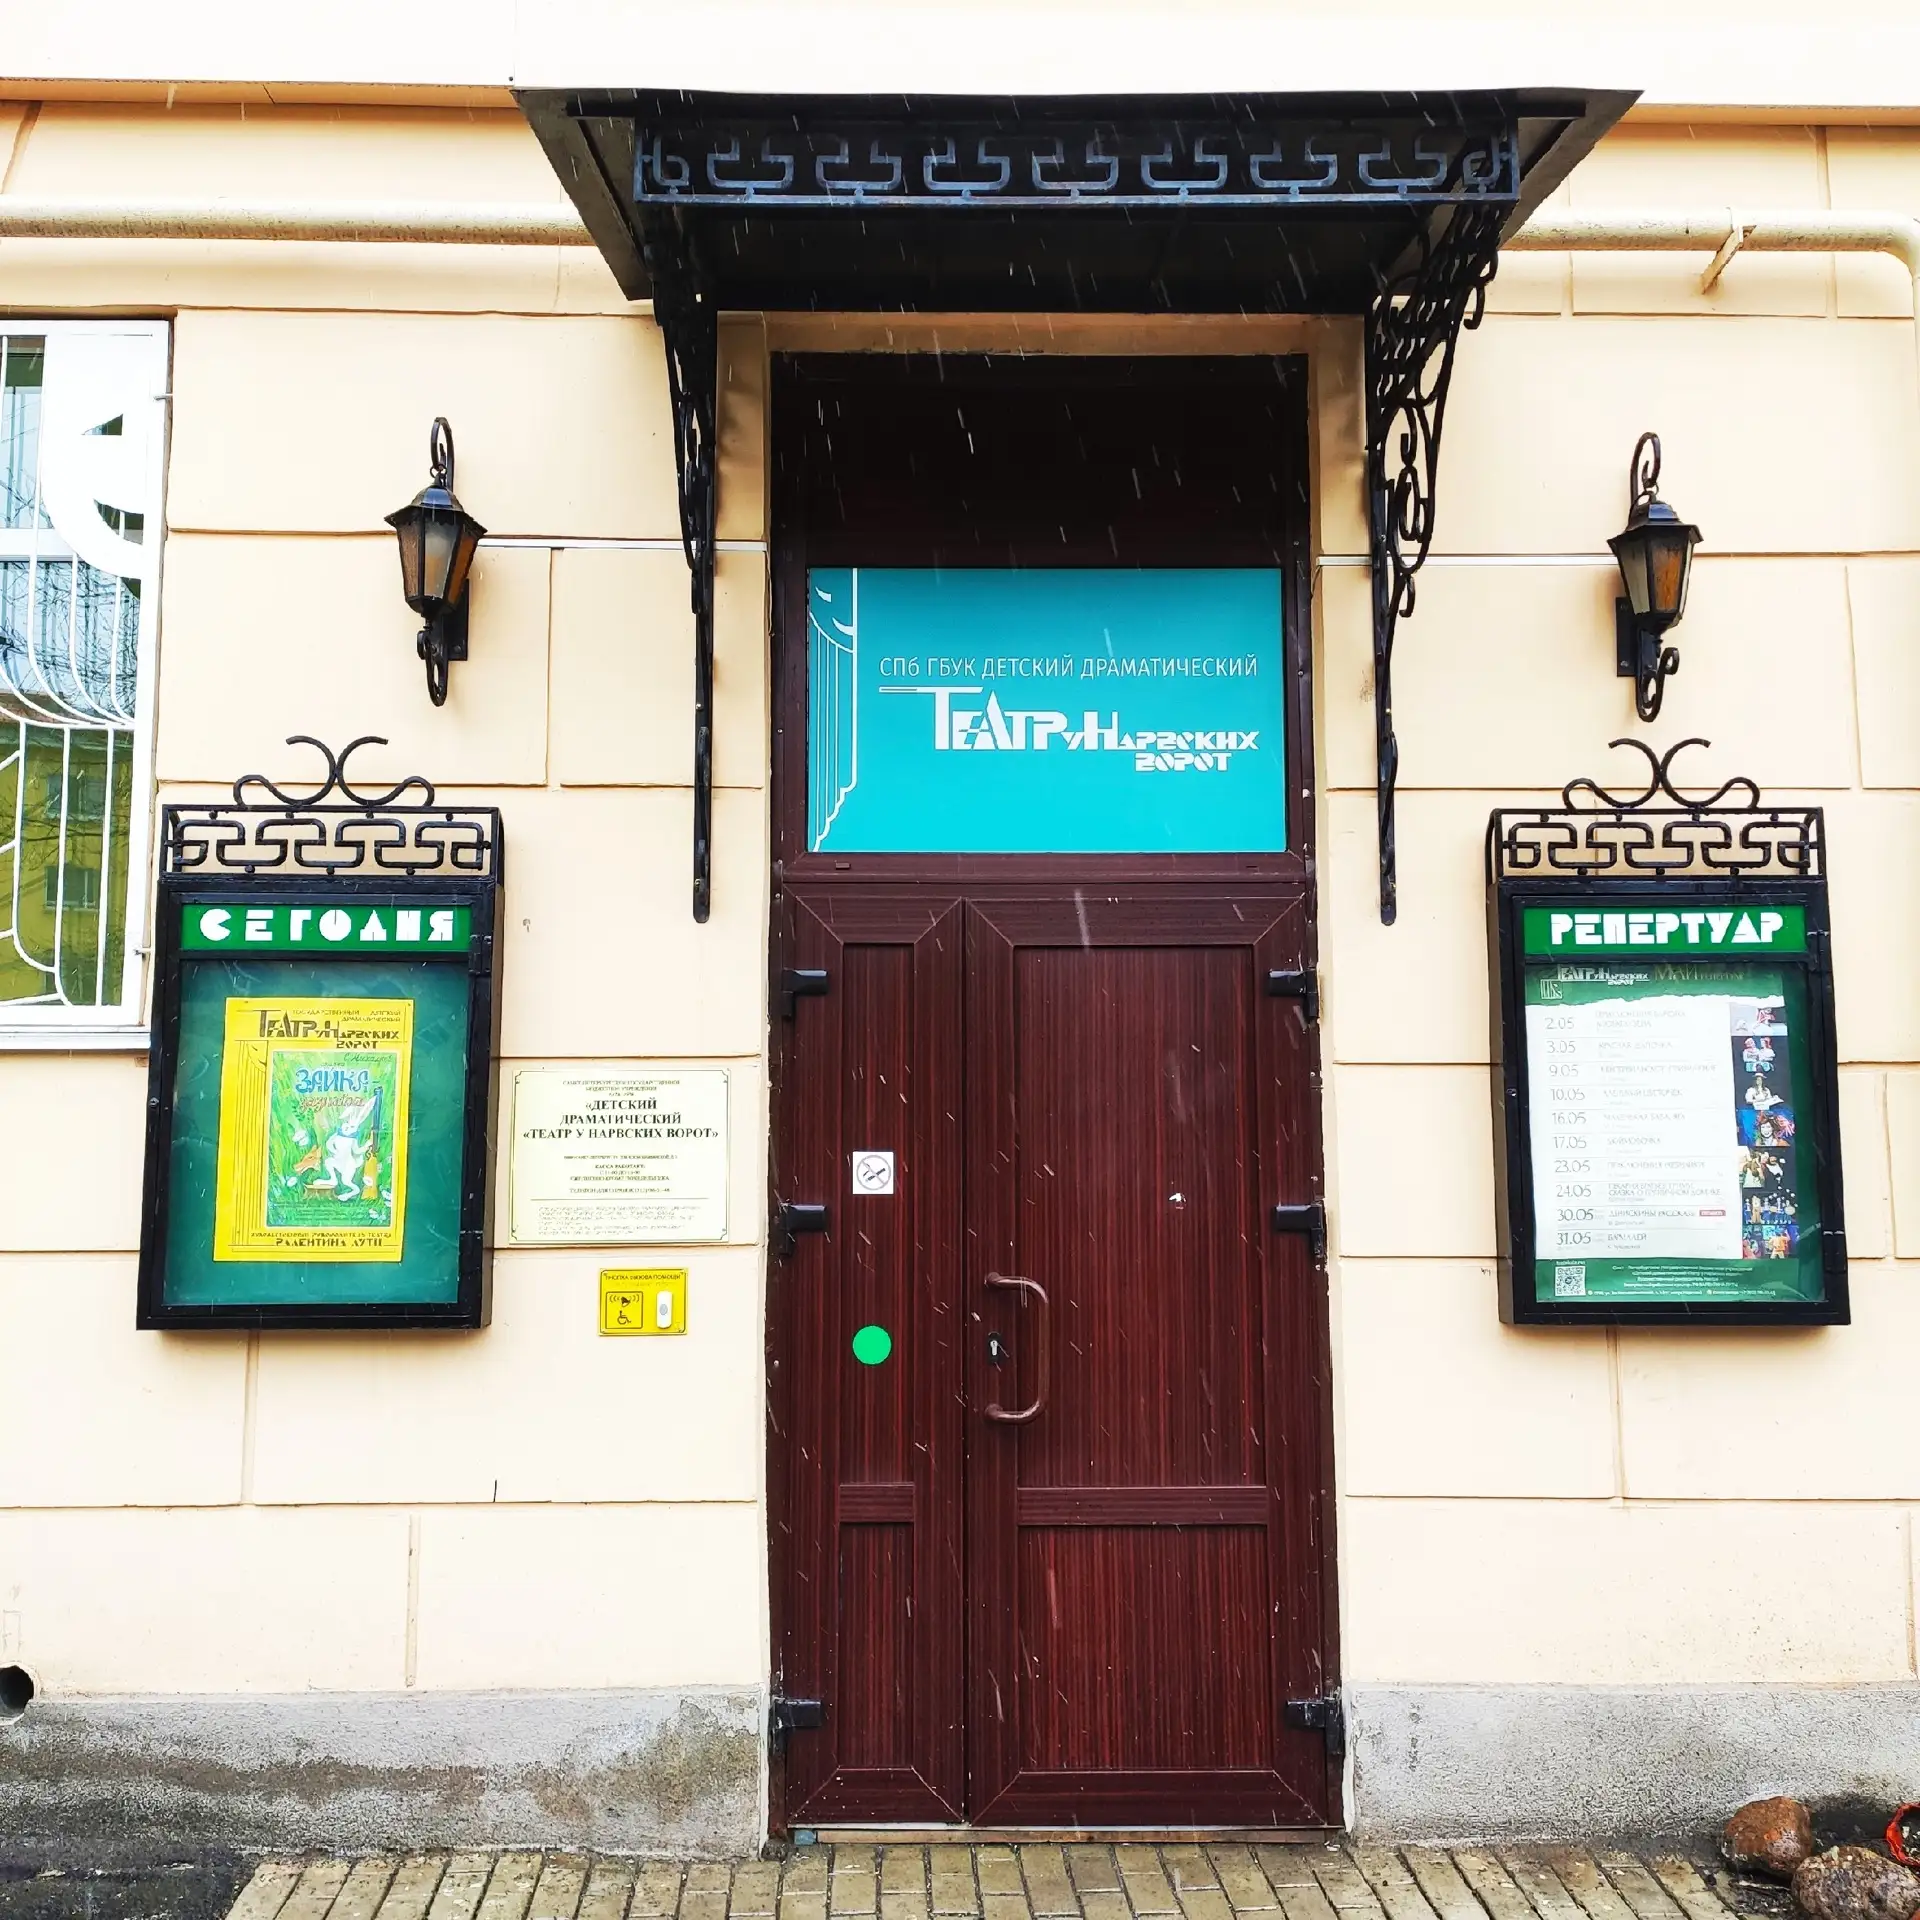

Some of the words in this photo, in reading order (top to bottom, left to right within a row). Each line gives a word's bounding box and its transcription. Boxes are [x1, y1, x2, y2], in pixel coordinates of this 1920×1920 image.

[879, 656, 920, 677] СПб
[928, 656, 976, 677] ГБУК
[981, 655, 1074, 680] ДЕТСКИЙ
[1080, 653, 1258, 680] ДРАМАТИЧЕСКИЙ
[199, 908, 454, 942] СЕГОДНЯ
[1550, 911, 1784, 945] РЕПЕРТУАР
[1544, 1017, 1575, 1030] 2.05
[1546, 1040, 1576, 1054] 3.05
[1548, 1064, 1579, 1077] 9.05
[1550, 1088, 1586, 1101] 10.05
[585, 1097, 657, 1111] «ДЕТСКИЙ
[560, 1111, 682, 1126] ДРАМАТИЧЕСКИЙ
[1551, 1112, 1587, 1125] 16.05
[523, 1128, 572, 1139] «ТЕАТР
[576, 1129, 585, 1139] У
[588, 1128, 662, 1139] НАРВСКИХ
[666, 1128, 719, 1138] ВОРОТ»
[1553, 1136, 1588, 1149] 17.05
[1554, 1160, 1591, 1173] 23.05
[1556, 1184, 1592, 1198] 24.05
[1557, 1208, 1594, 1222] 30.05
[1557, 1232, 1592, 1245] 31.05
